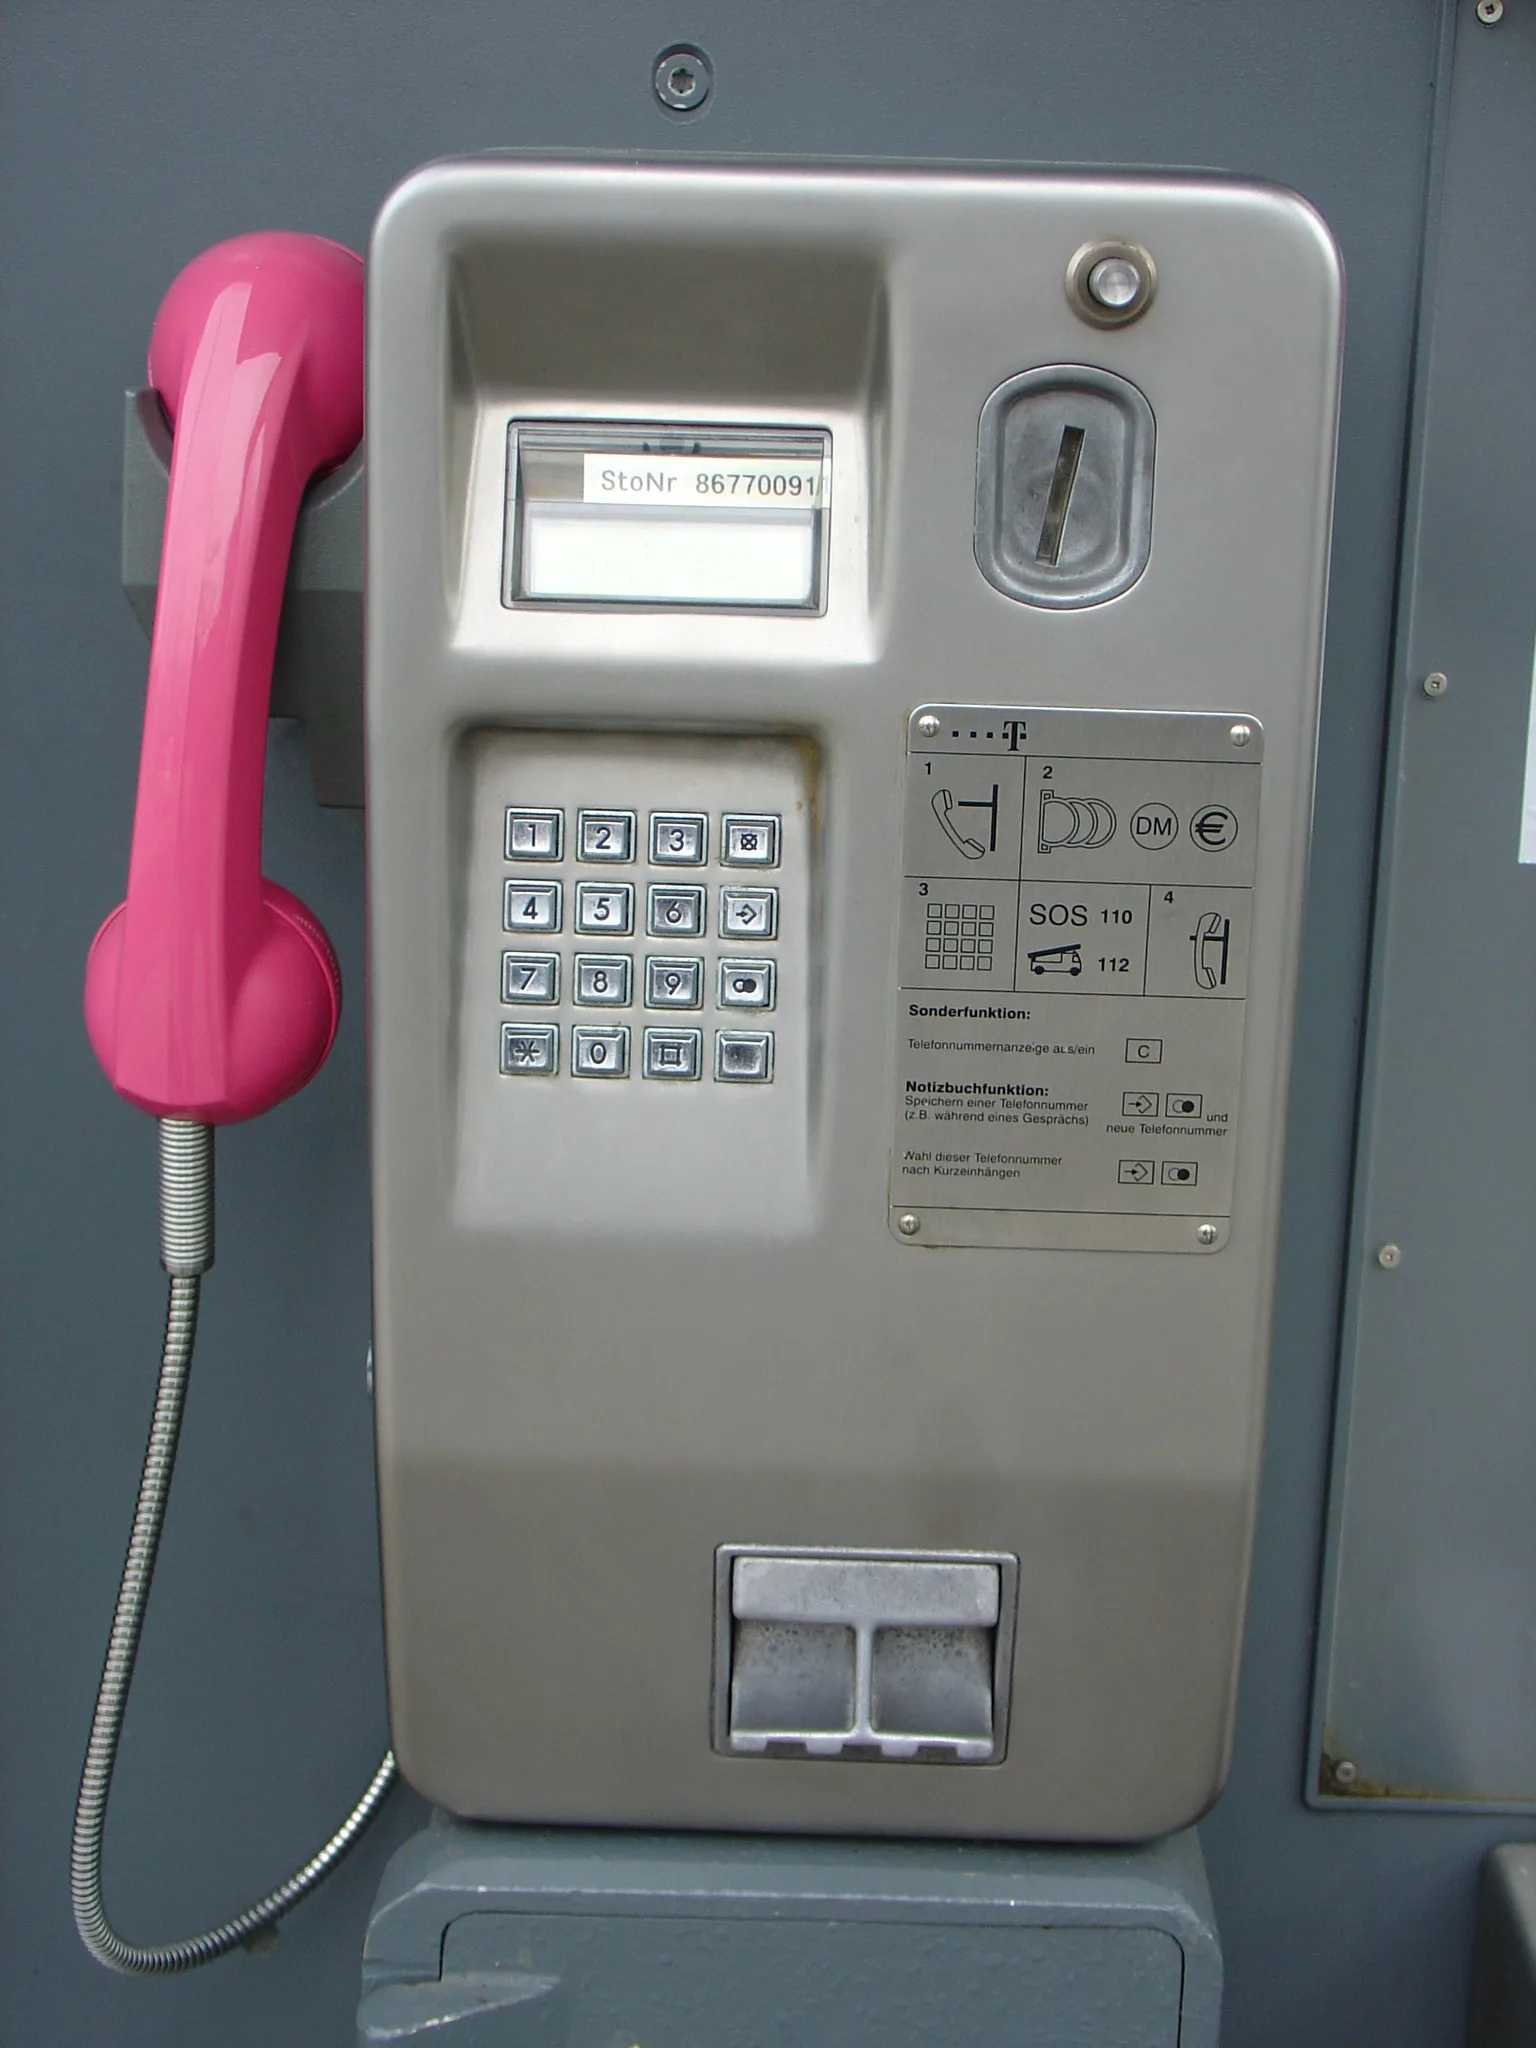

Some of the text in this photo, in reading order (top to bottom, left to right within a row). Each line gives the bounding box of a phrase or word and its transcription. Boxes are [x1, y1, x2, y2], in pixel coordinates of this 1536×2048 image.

[600, 470, 678, 492] StoNr
[925, 762, 932, 775] 1
[1042, 766, 1053, 779] 2
[1136, 816, 1172, 836] DM
[527, 824, 685, 852] 1 2 3
[918, 883, 929, 897] 3
[1164, 891, 1174, 904] 4
[522, 896, 682, 924] 4 5 6
[1029, 903, 1133, 926] SOS 110
[1098, 957, 1130, 972] 112
[520, 967, 681, 995] 7 8 9
[908, 1004, 1031, 1020] Sonderfunktion:
[589, 1042, 606, 1065] 0
[1137, 1044, 1150, 1059] C
[905, 1081, 1049, 1097] Notizbuchfunktion:
[904, 1095, 1088, 1112] Speichern einer Telefonnummer
[934, 1112, 984, 1123] während
[987, 1113, 1019, 1124] eines
[1022, 1112, 1089, 1127] Gesprächs)
[1206, 1113, 1229, 1123] und
[1106, 1123, 1228, 1137] neue Telefonnummer
[935, 1153, 971, 1164] dieser
[974, 1152, 1063, 1166] Telefonnummer
[902, 1165, 1021, 1180] nach Kurzeinhängen
